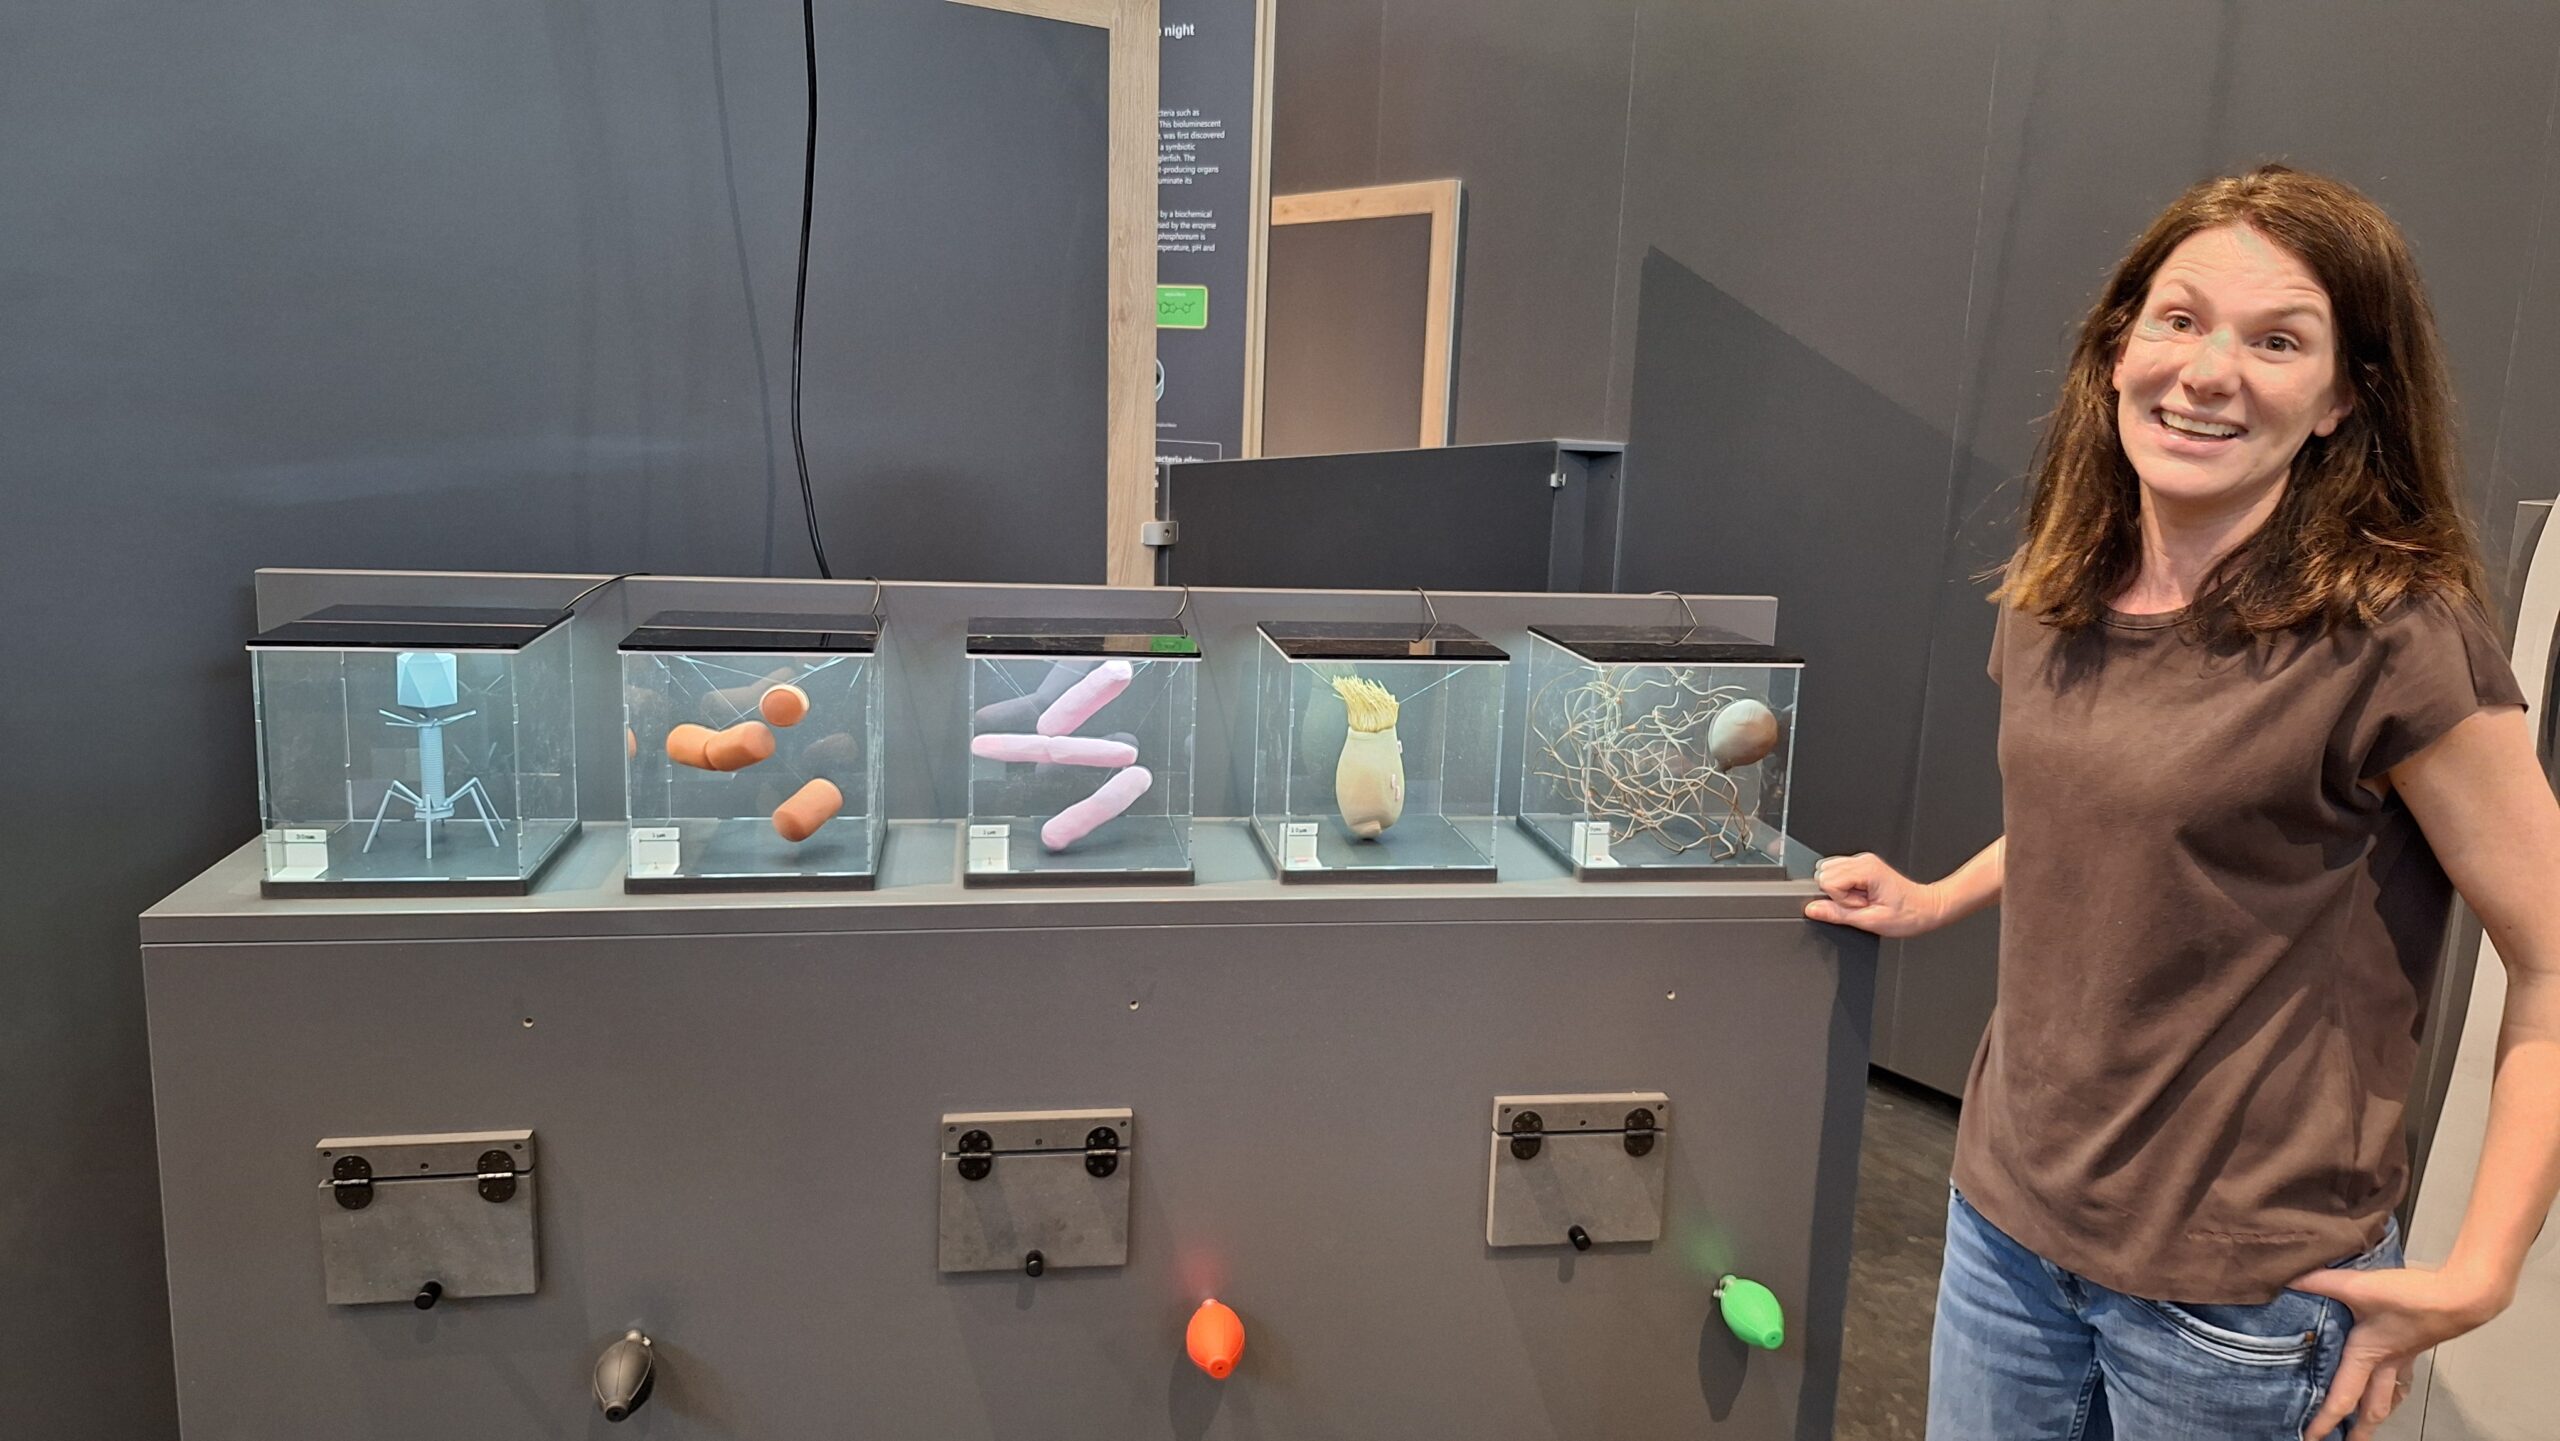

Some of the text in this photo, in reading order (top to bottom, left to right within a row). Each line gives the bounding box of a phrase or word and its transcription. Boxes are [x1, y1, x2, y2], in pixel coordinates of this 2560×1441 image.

[1164, 23, 1195, 40] night
[1176, 108, 1191, 117] such
[1160, 120, 1221, 128] This bioluminescent
[1177, 131, 1189, 140] first
[1190, 130, 1225, 139] discovered
[1165, 143, 1196, 153] symbiotic
[1183, 154, 1196, 162] The
[1197, 166, 1219, 175] organs
[1184, 177, 1193, 185] its
[1160, 210, 1168, 220] by
[1174, 210, 1213, 218] biochemical
[1171, 221, 1179, 231] by
[1180, 221, 1191, 229] the
[1192, 223, 1217, 231] enzyme
[1202, 243, 1216, 252] and
